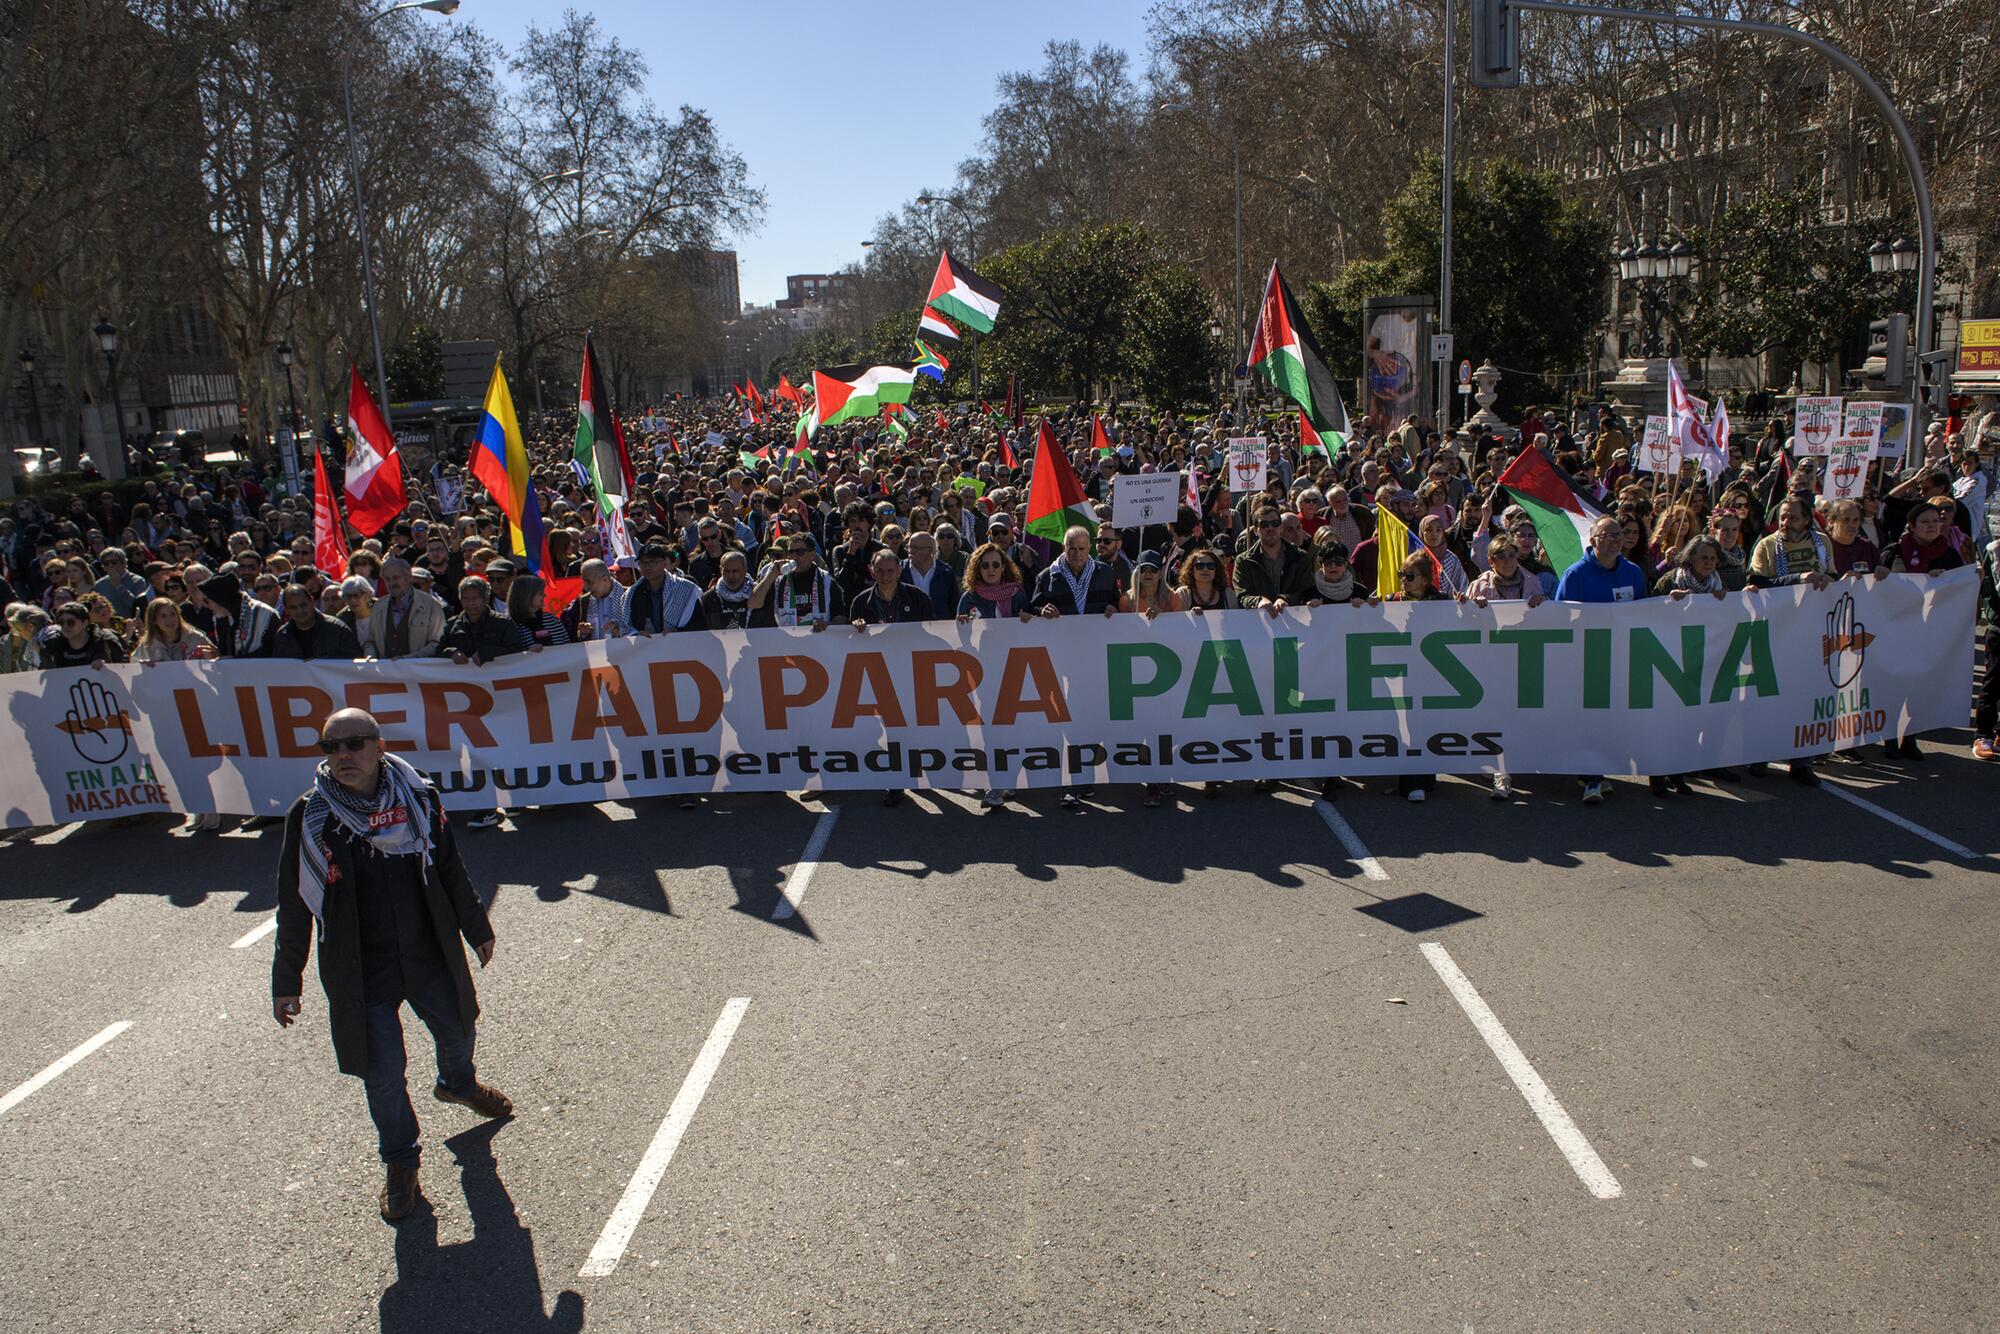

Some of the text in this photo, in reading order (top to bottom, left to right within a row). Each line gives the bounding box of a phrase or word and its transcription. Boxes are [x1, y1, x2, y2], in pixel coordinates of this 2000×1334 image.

[1798, 404, 1840, 413] PALESTINA
[1847, 409, 1881, 418] PALESTINA
[394, 431, 430, 445] Ginos
[1231, 444, 1265, 453] PALESTINA
[1831, 445, 1869, 456] PALESTINA
[173, 619, 1780, 758] LIBERTAD PARA PALESTINA
[1813, 687, 1871, 721] NO A LA
[1793, 709, 1887, 749] IMPUNIDAD
[429, 728, 1504, 793] www.libertadparapalestina.es
[65, 762, 159, 791] FIN A LA
[65, 784, 171, 814] MASACRE
[369, 810, 394, 827] UGT
